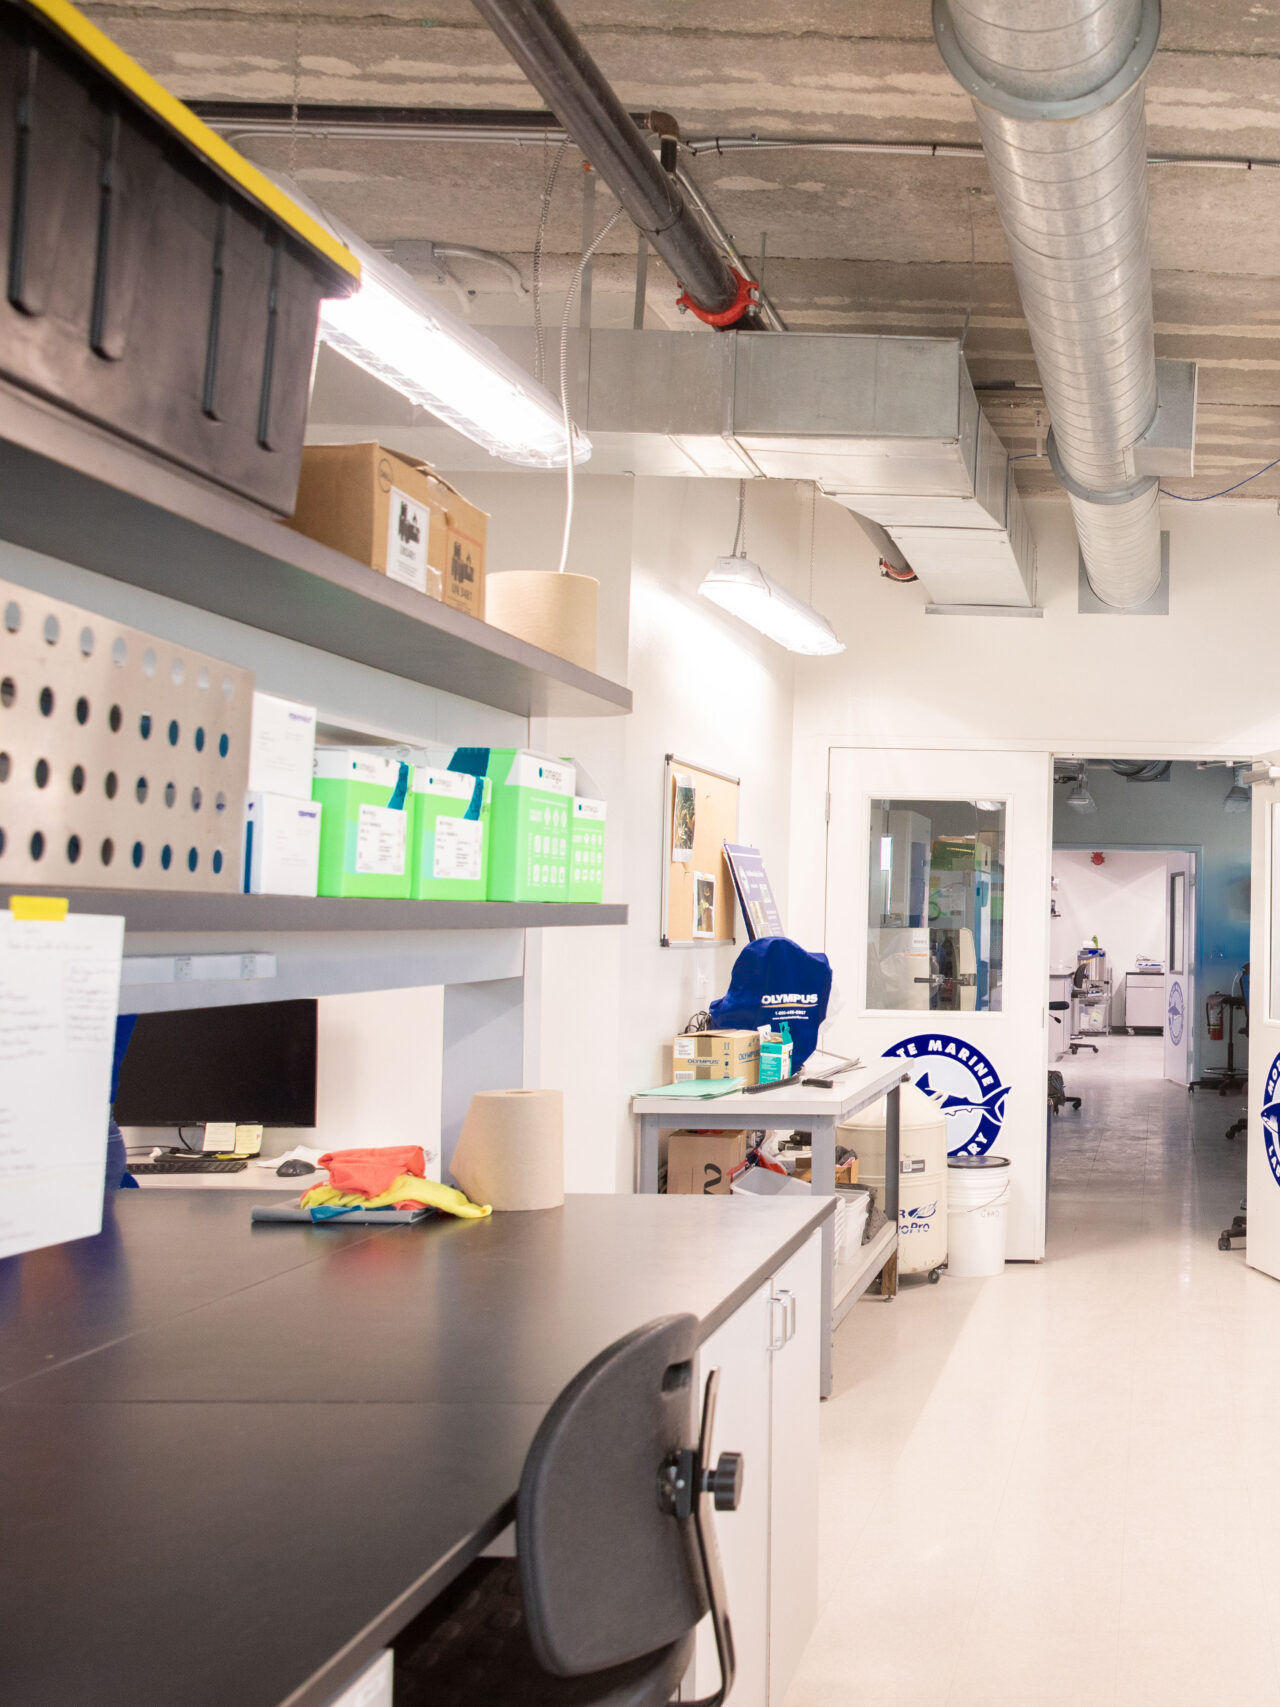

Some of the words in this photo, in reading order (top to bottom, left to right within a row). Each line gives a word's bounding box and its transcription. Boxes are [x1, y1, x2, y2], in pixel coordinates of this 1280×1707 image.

[761, 993, 818, 1005] OLYMPUS
[895, 1042, 918, 1058] TE
[928, 1039, 995, 1087] MARINE
